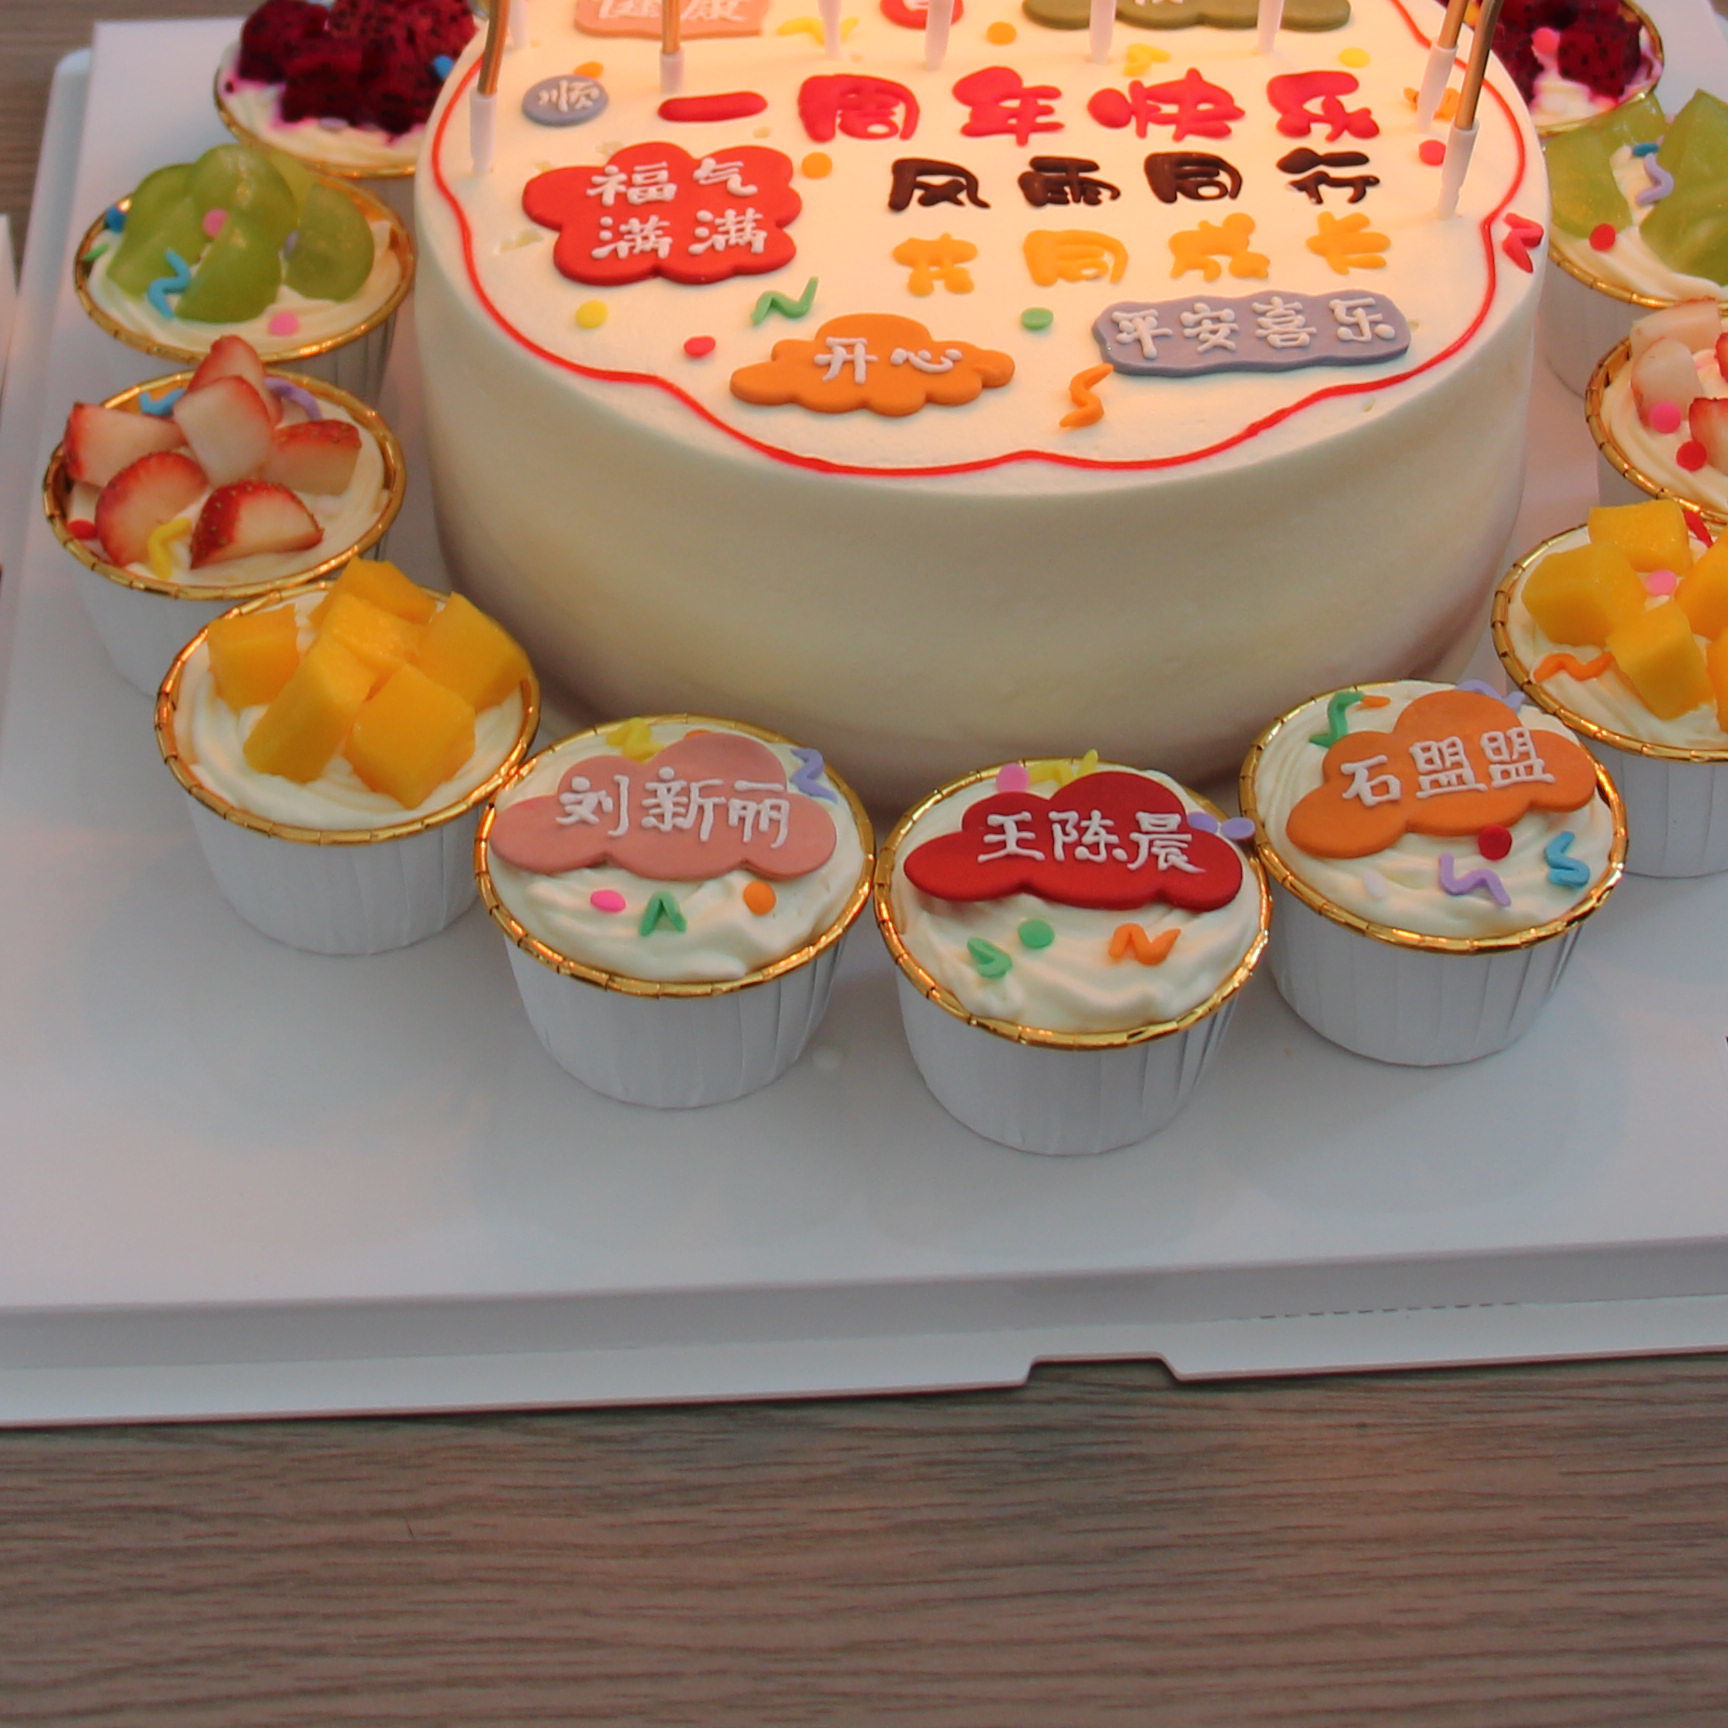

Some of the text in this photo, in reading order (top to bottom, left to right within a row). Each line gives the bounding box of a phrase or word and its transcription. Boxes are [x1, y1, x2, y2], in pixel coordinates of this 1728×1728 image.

[538, 80, 600, 112] 顺
[658, 66, 1380, 146] 一周年快乐
[586, 157, 758, 206] 福气
[887, 147, 1380, 211] 风雨同行
[591, 208, 768, 260] 满满
[893, 212, 1392, 297] 共同成长
[1111, 296, 1396, 359] 平安喜乐
[813, 335, 962, 385] 开心
[1340, 726, 1556, 807] 石盟盟
[556, 766, 791, 848] 刘新丽
[976, 809, 1206, 874] 王陈晨
